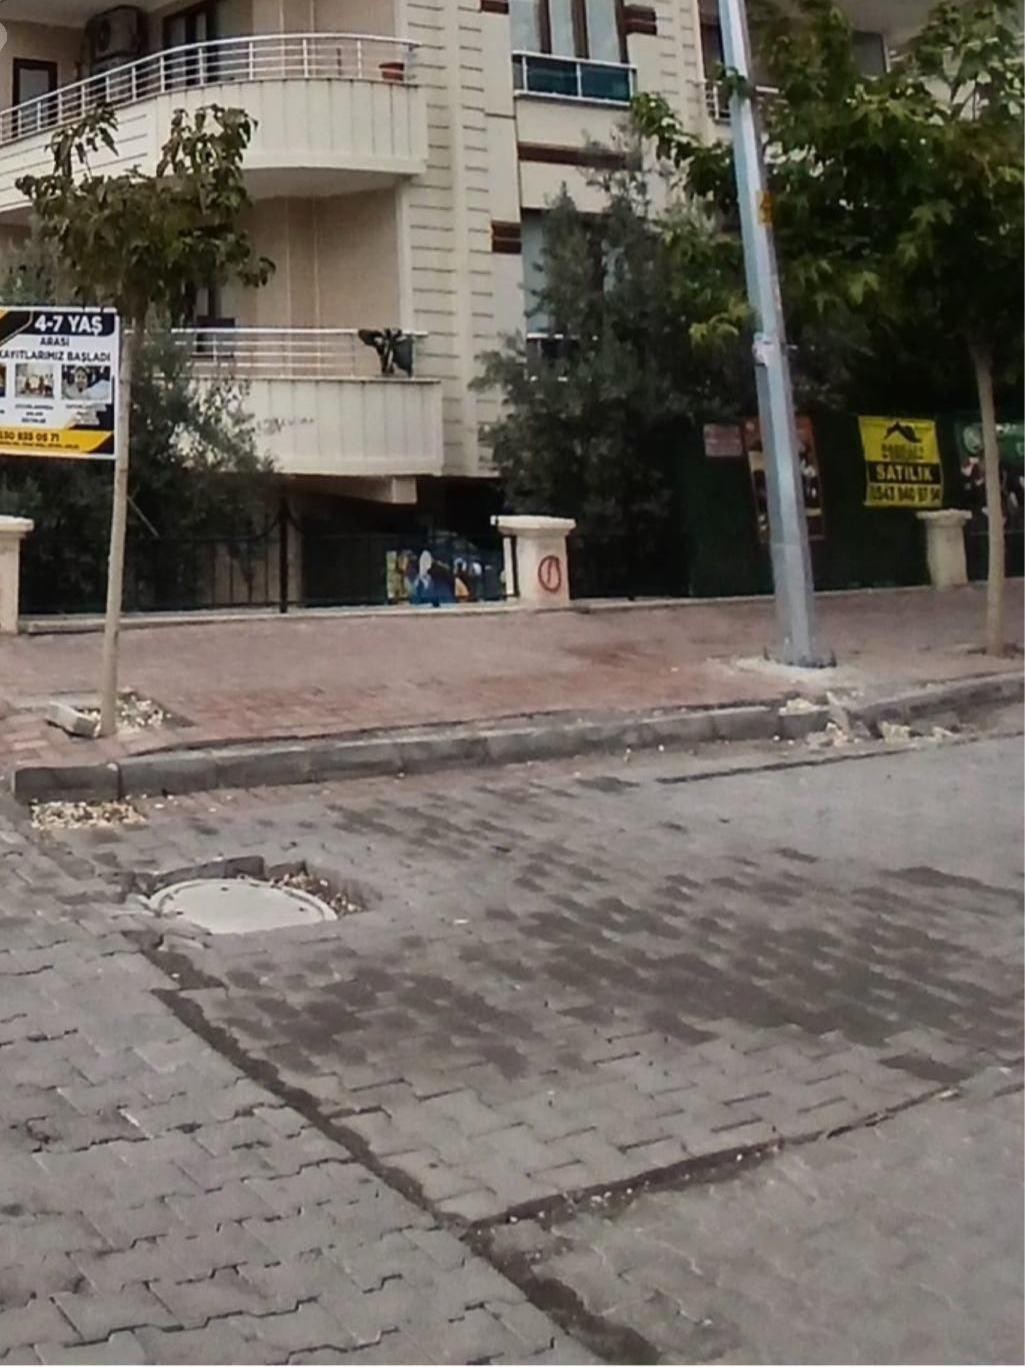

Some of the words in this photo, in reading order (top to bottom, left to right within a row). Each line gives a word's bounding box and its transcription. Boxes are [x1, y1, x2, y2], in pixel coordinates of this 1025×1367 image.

[35, 314, 63, 332] 4-7
[68, 315, 103, 336] YAŞ
[876, 464, 933, 481] SATILIK
